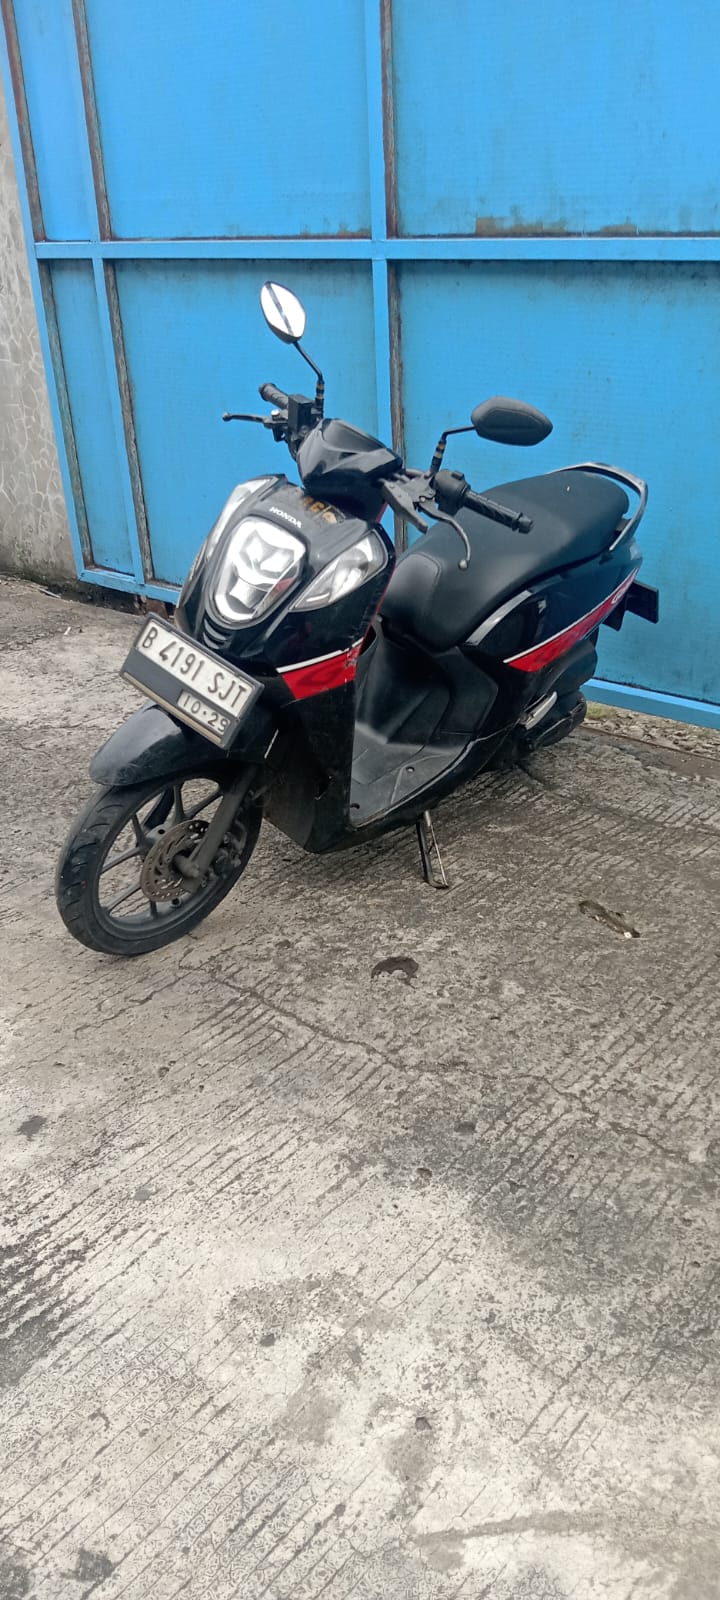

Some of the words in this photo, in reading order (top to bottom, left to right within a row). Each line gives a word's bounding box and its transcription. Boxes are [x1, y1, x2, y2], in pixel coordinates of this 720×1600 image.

[269, 507, 302, 528] HONDA
[142, 626, 158, 649] B
[159, 641, 205, 681] 4191
[207, 671, 247, 708] SJT
